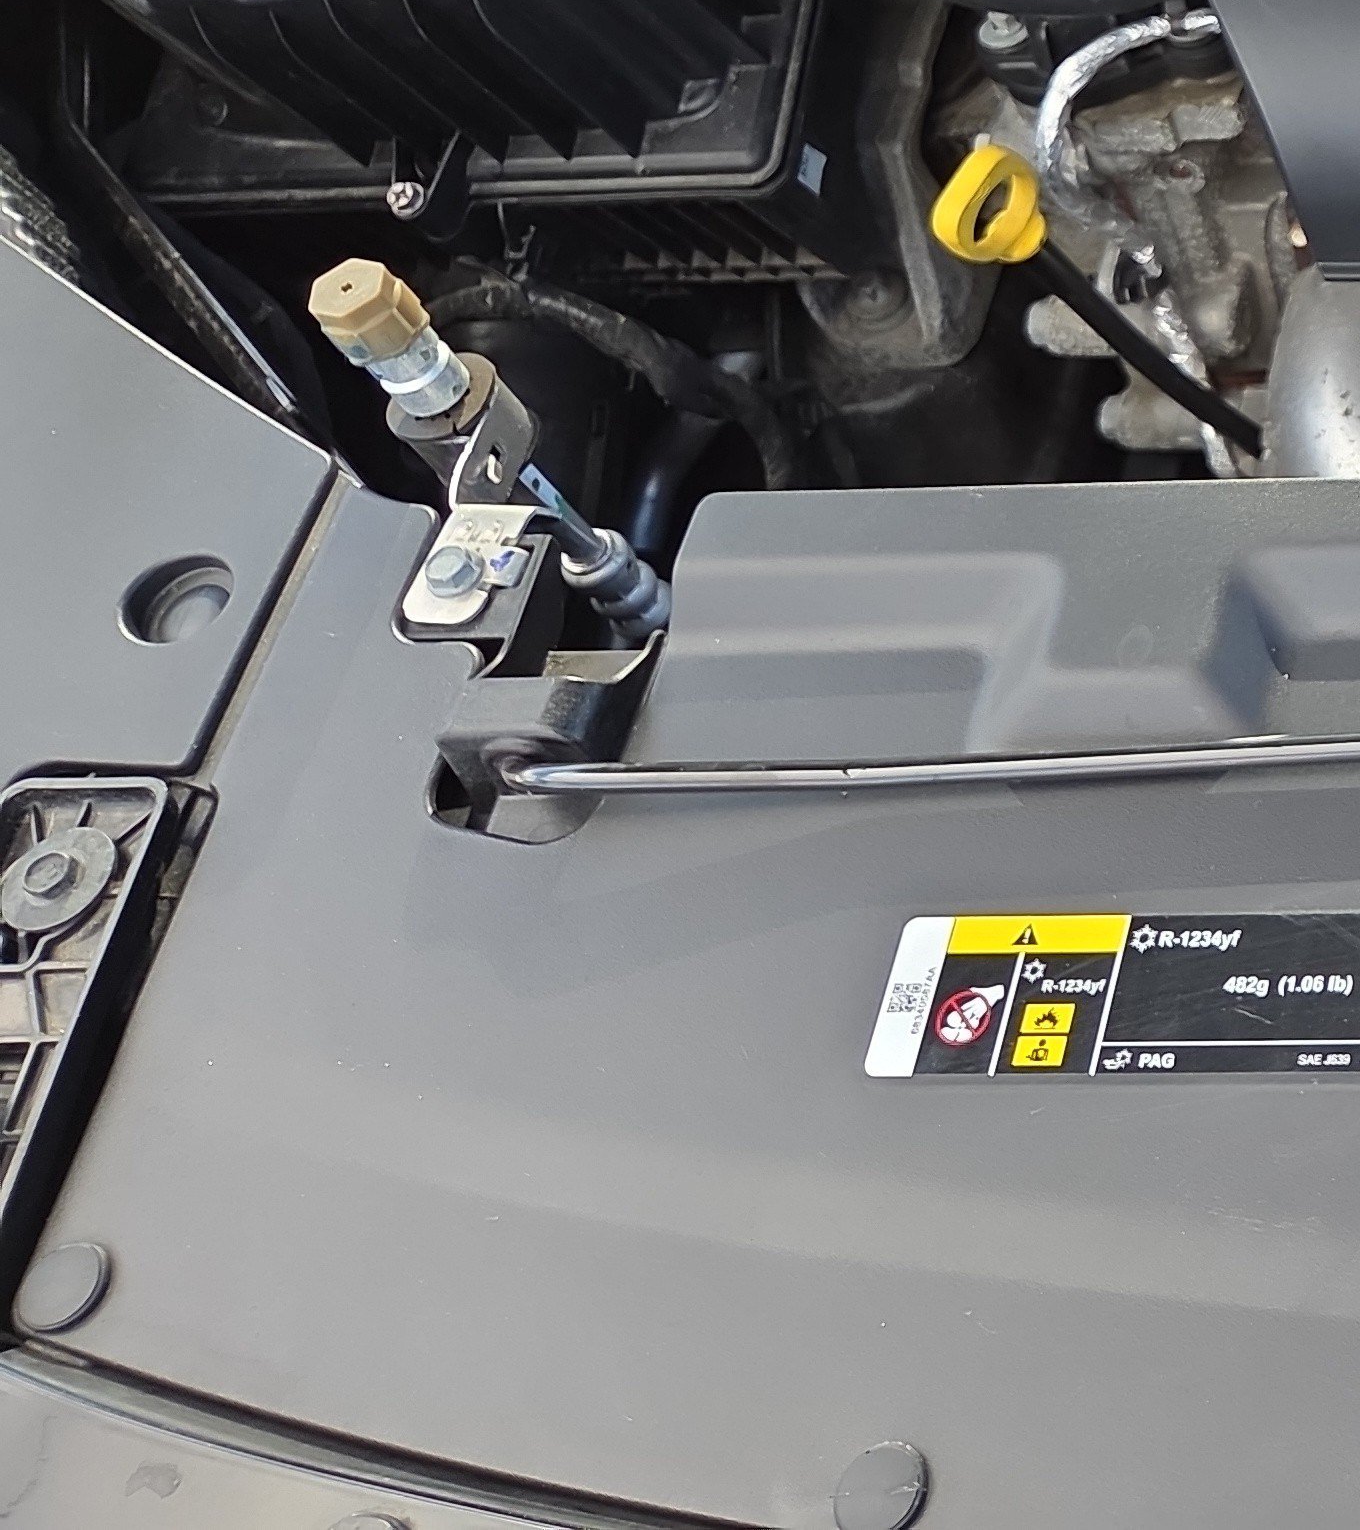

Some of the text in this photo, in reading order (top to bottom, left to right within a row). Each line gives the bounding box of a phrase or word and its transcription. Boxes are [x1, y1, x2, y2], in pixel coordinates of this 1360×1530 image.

[1157, 928, 1243, 952] R-1234yf
[1040, 977, 1107, 997] R-1234yf
[1222, 974, 1354, 999] 482g (1.06 lb)
[1137, 1051, 1176, 1070] PAG
[1296, 1053, 1323, 1066] SAE
